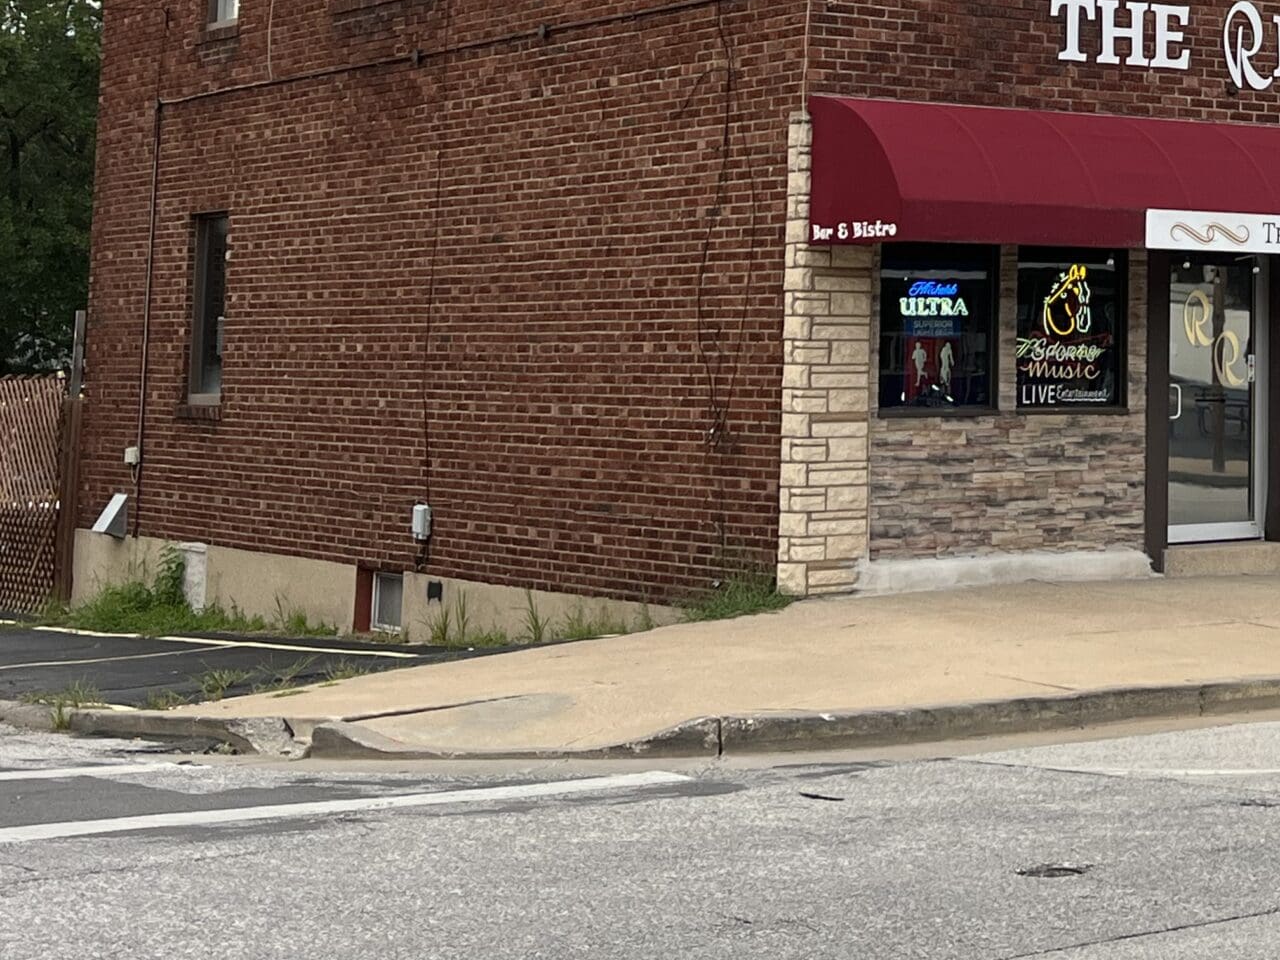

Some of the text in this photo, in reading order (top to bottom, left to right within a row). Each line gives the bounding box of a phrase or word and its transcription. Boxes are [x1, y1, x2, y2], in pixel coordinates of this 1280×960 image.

[812, 220, 897, 241] Bar & Bistro
[899, 297, 969, 316] ULTRA
[1019, 360, 1101, 379] Music
[1022, 384, 1056, 404] LIVE
